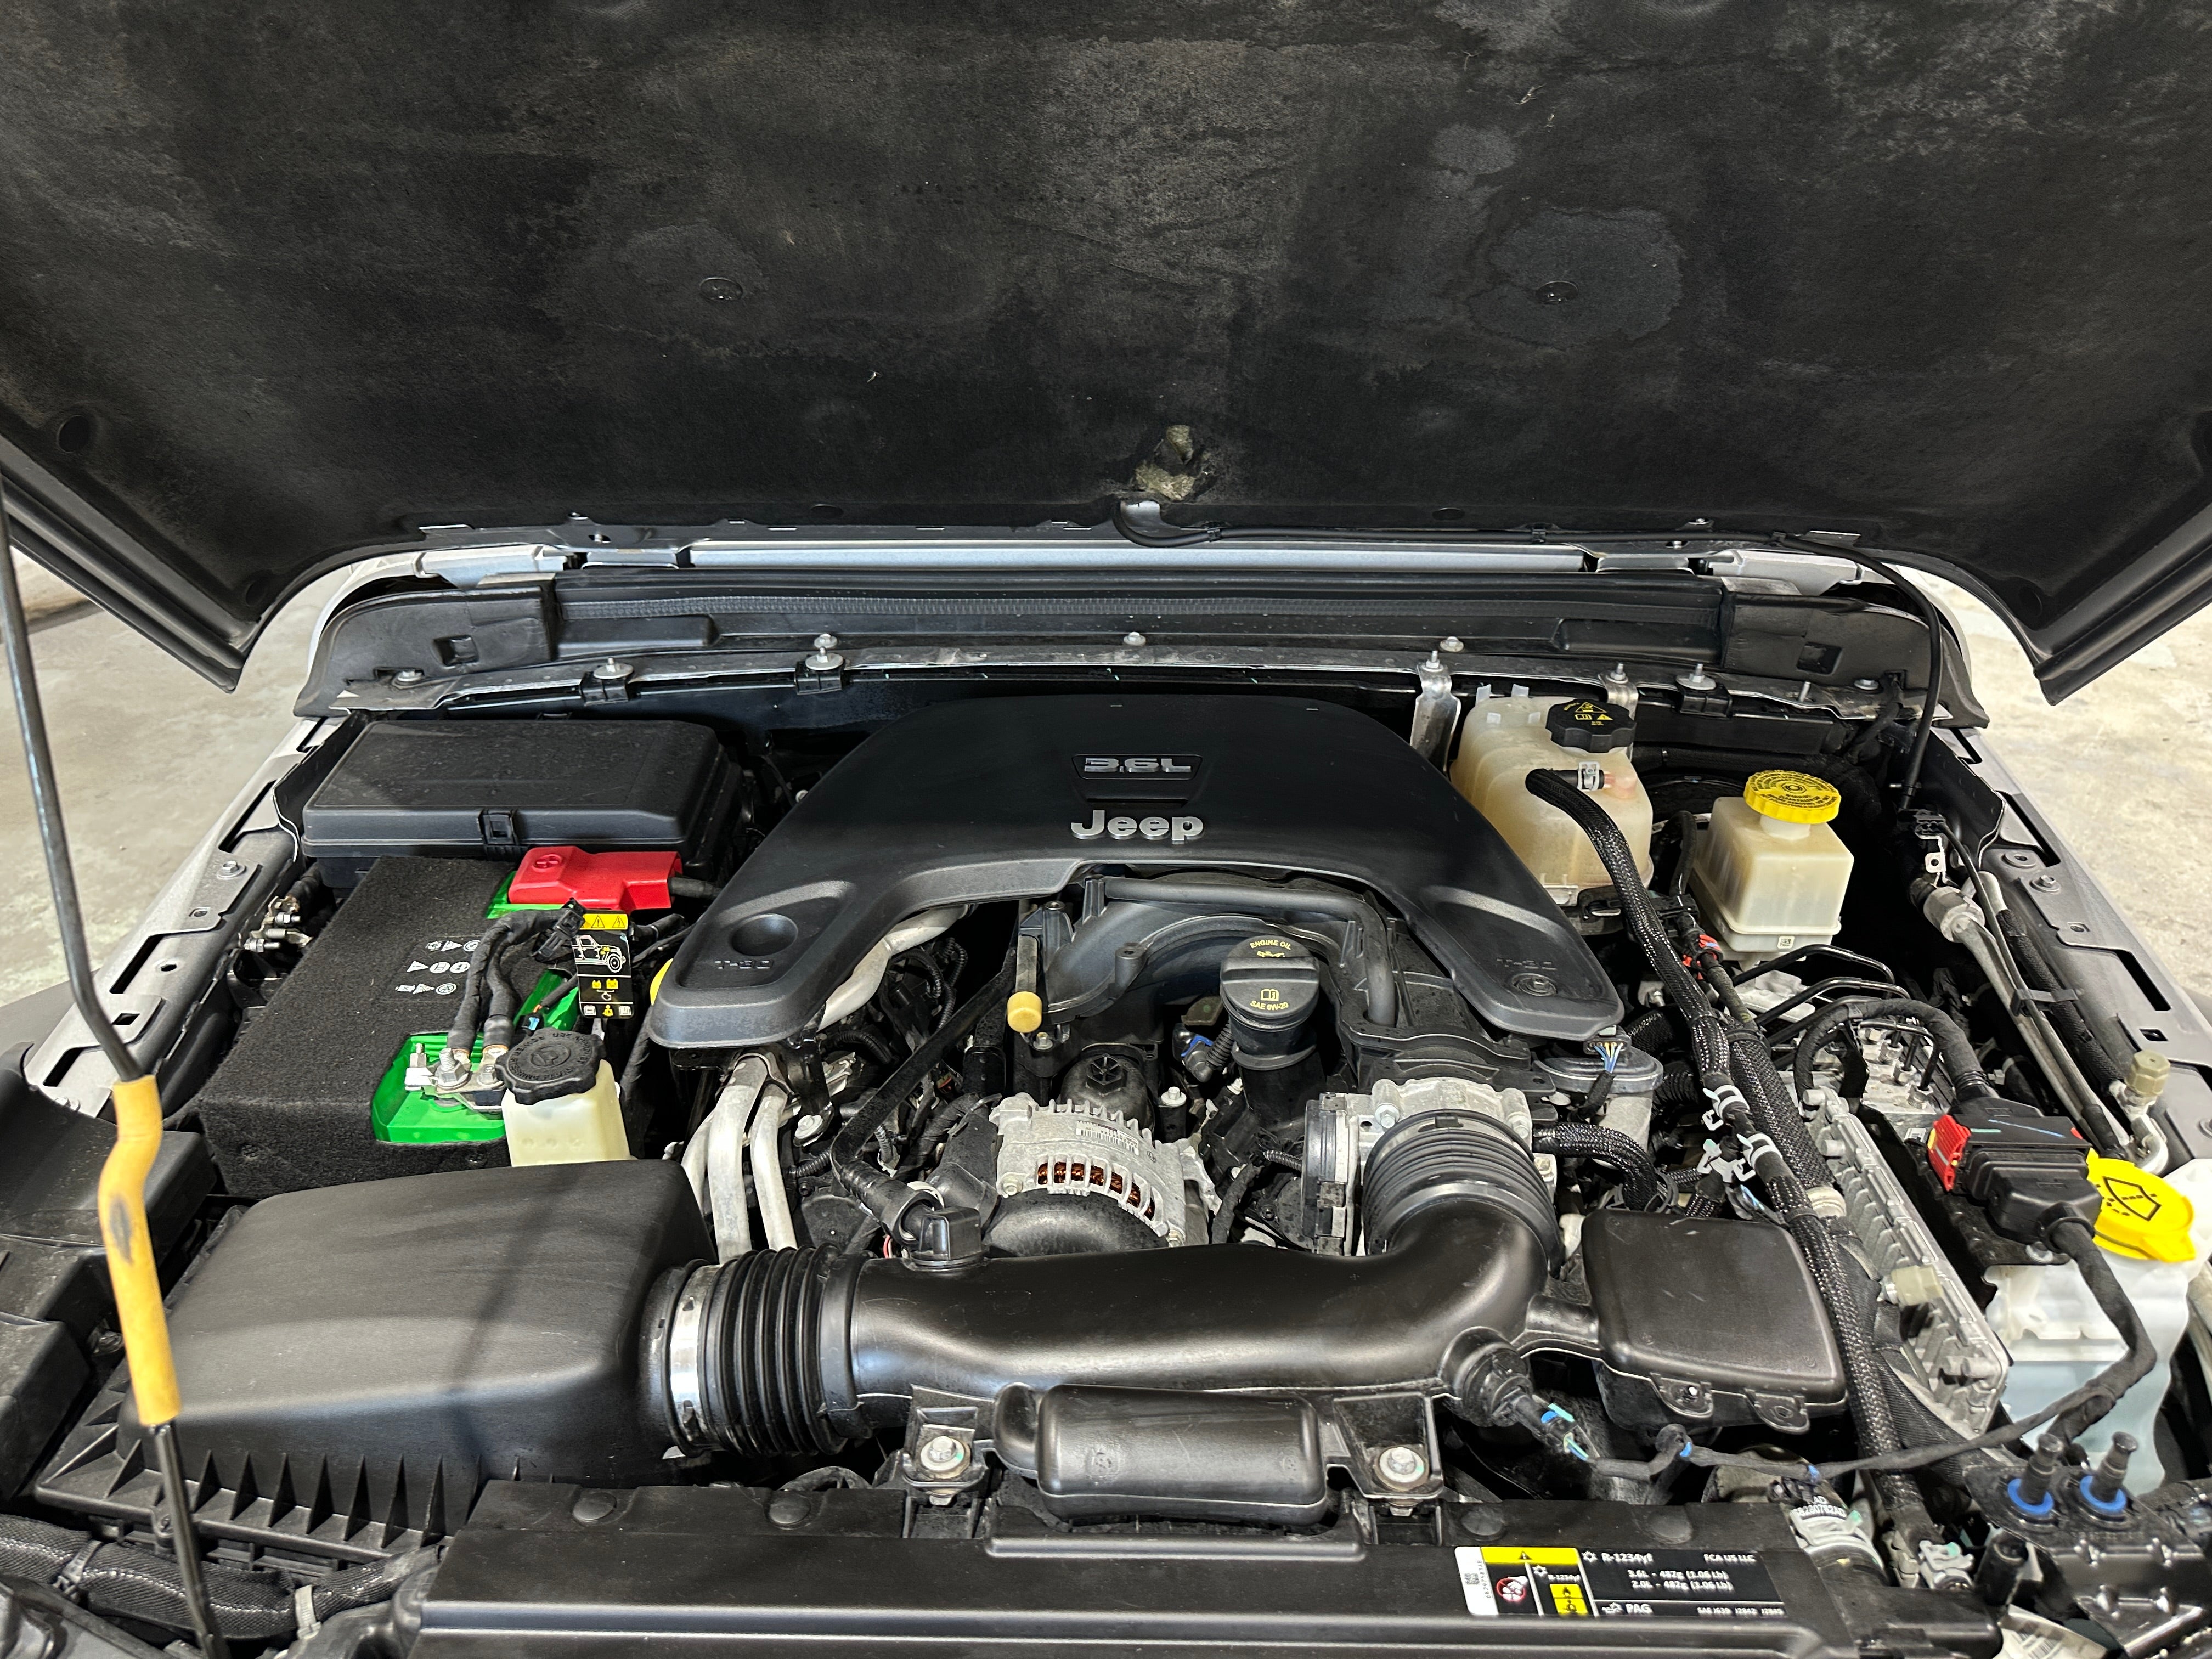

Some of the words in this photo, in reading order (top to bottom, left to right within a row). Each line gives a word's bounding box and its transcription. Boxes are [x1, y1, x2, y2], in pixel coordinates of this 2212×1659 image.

[1084, 758, 1192, 773] 3.6L
[1070, 810, 1204, 845] Jeep
[1250, 940, 1279, 949] ENGINE
[1279, 941, 1291, 950] OIL
[1250, 1000, 1266, 1010] SAE
[1267, 1001, 1289, 1010] 0W-20
[1601, 1553, 1654, 1564] R-1234yf
[1703, 1554, 1723, 1562] FCA
[1723, 1554, 1738, 1562] US
[1627, 1570, 1650, 1578] 3.6L
[1631, 1580, 1654, 1589] 2.0L
[1626, 1604, 1654, 1614] PAG
